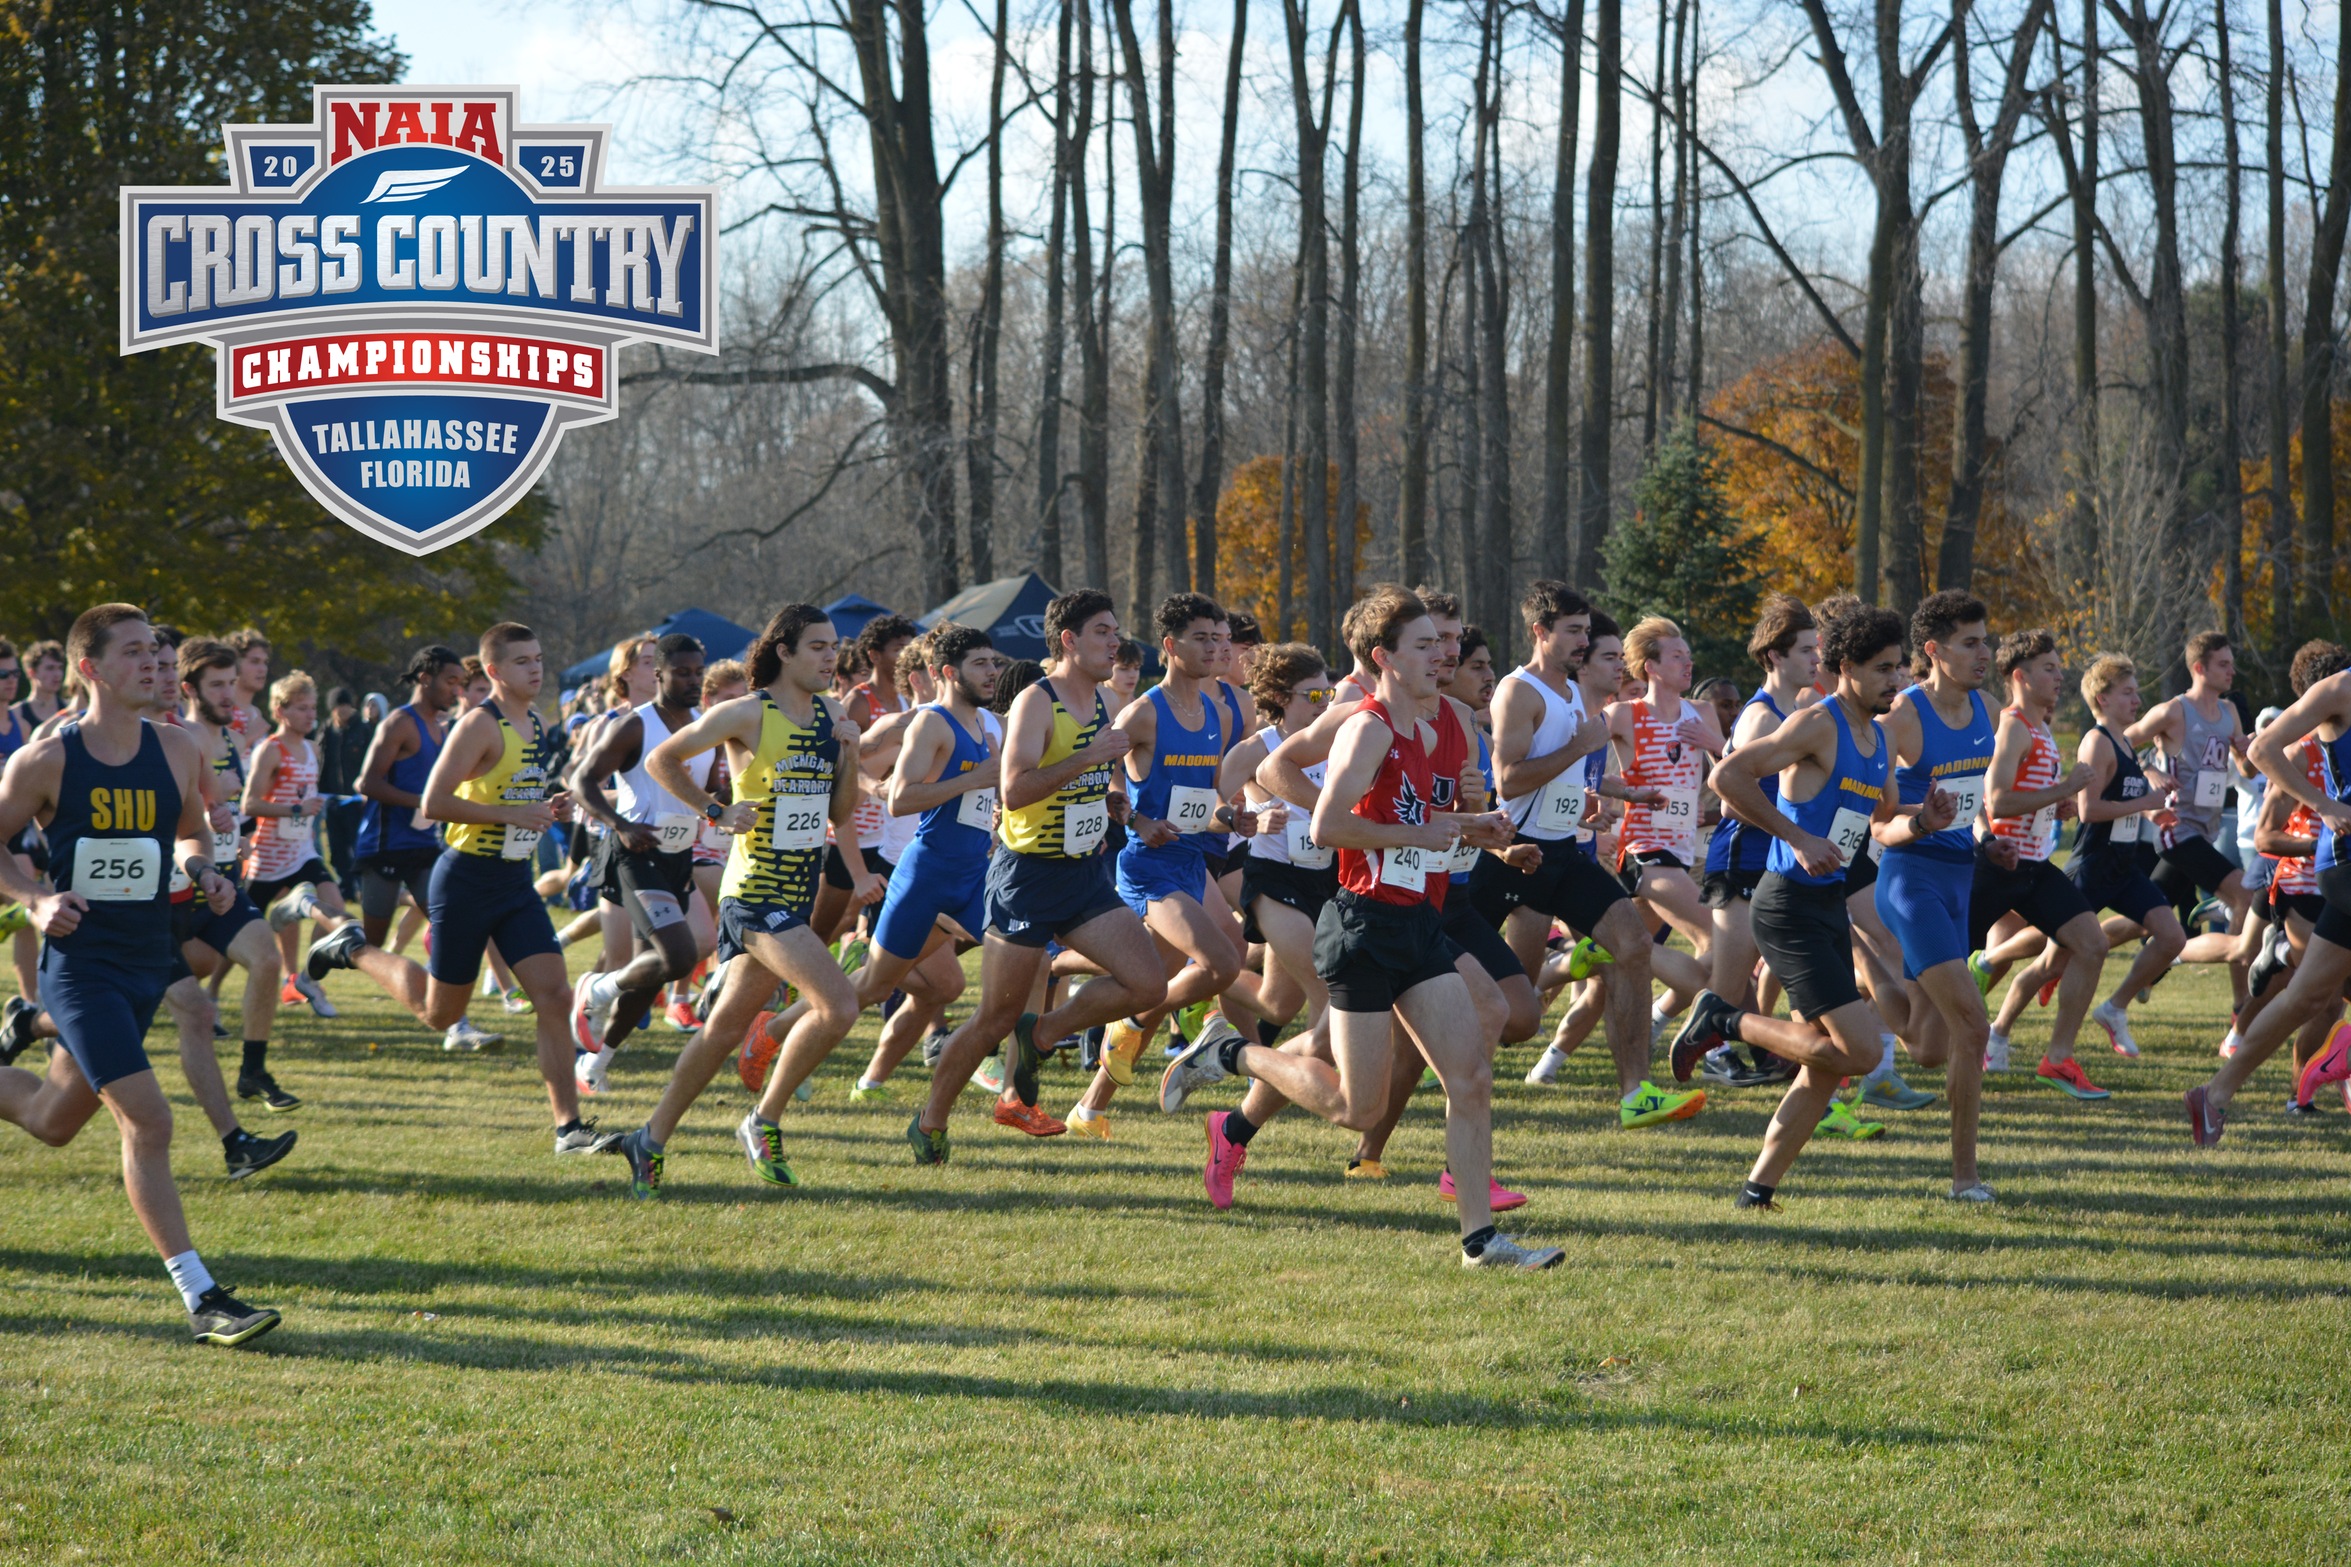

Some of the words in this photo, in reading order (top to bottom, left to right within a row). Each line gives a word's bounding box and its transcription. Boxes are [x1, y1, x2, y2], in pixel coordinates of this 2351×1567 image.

[1163, 754, 1219, 767] MADONN
[2202, 736, 2228, 770] AQ
[1930, 756, 1992, 777] MADONN
[2209, 783, 2220, 795] 21
[90, 787, 156, 832] SHU
[975, 795, 992, 814] 211
[1179, 802, 1207, 819] 210
[1555, 797, 1579, 815] 192
[1665, 801, 1689, 816] 153
[1958, 793, 1974, 811] 15
[787, 811, 821, 831] 226
[1075, 816, 1103, 838] 228
[514, 825, 538, 842] 225
[663, 826, 689, 840] 197
[1838, 828, 1862, 849] 216
[1394, 846, 1420, 871] 240
[89, 858, 145, 880] 256
